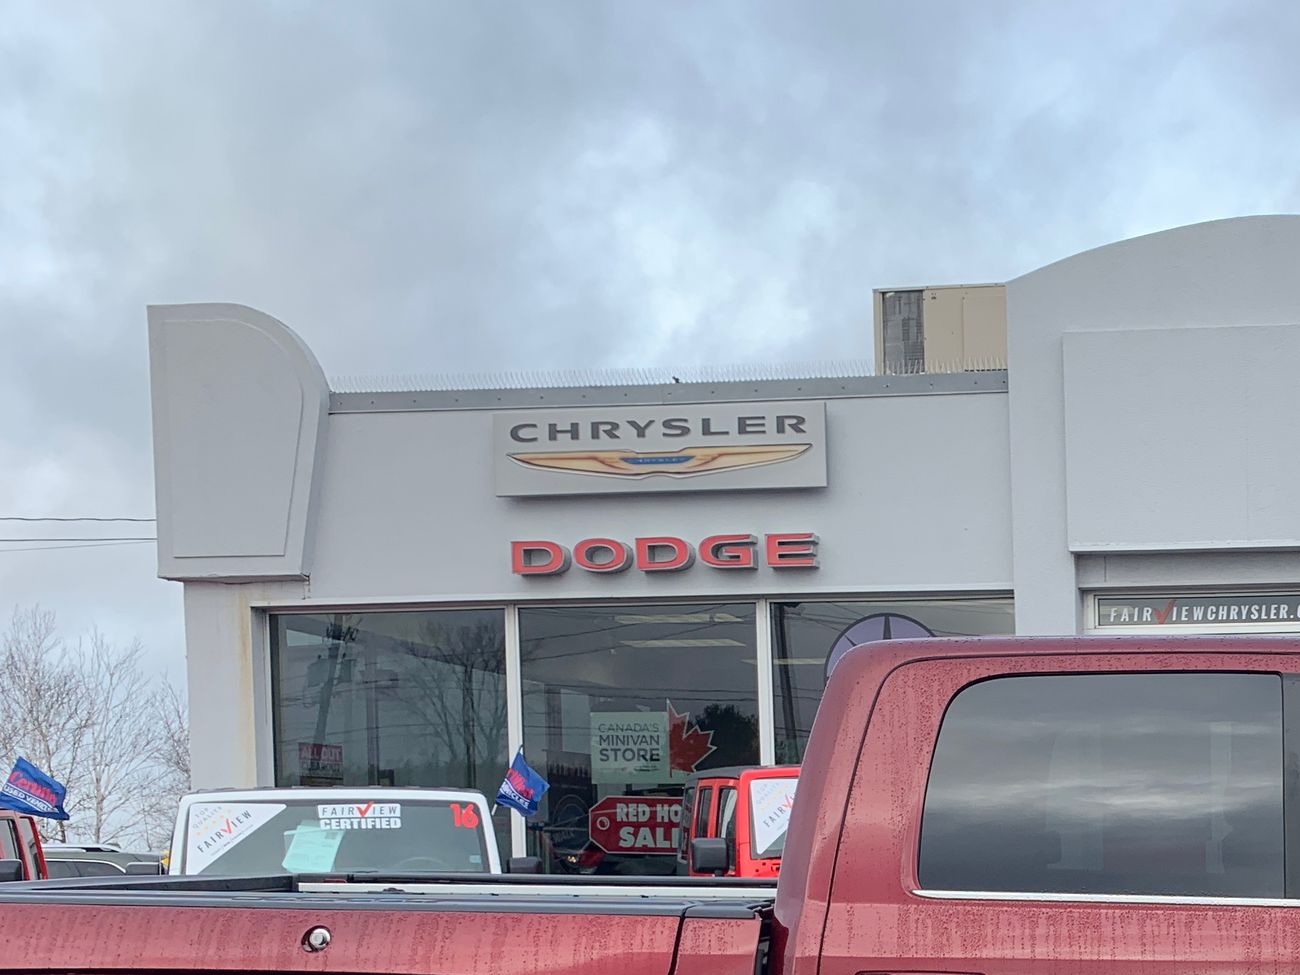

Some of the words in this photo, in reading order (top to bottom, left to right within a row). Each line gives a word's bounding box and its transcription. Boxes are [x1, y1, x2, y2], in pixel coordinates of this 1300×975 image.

[510, 415, 807, 443] CHRYSLER
[511, 532, 820, 576] DODGE
[598, 723, 660, 733] CANADA'S
[600, 734, 660, 746] MINIVAN
[600, 748, 661, 762] STORE
[322, 801, 398, 817] FAIRVIEW
[450, 803, 479, 829] 16
[616, 803, 651, 822] RED
[656, 804, 683, 823] HO
[320, 818, 402, 830] CERTIFIED
